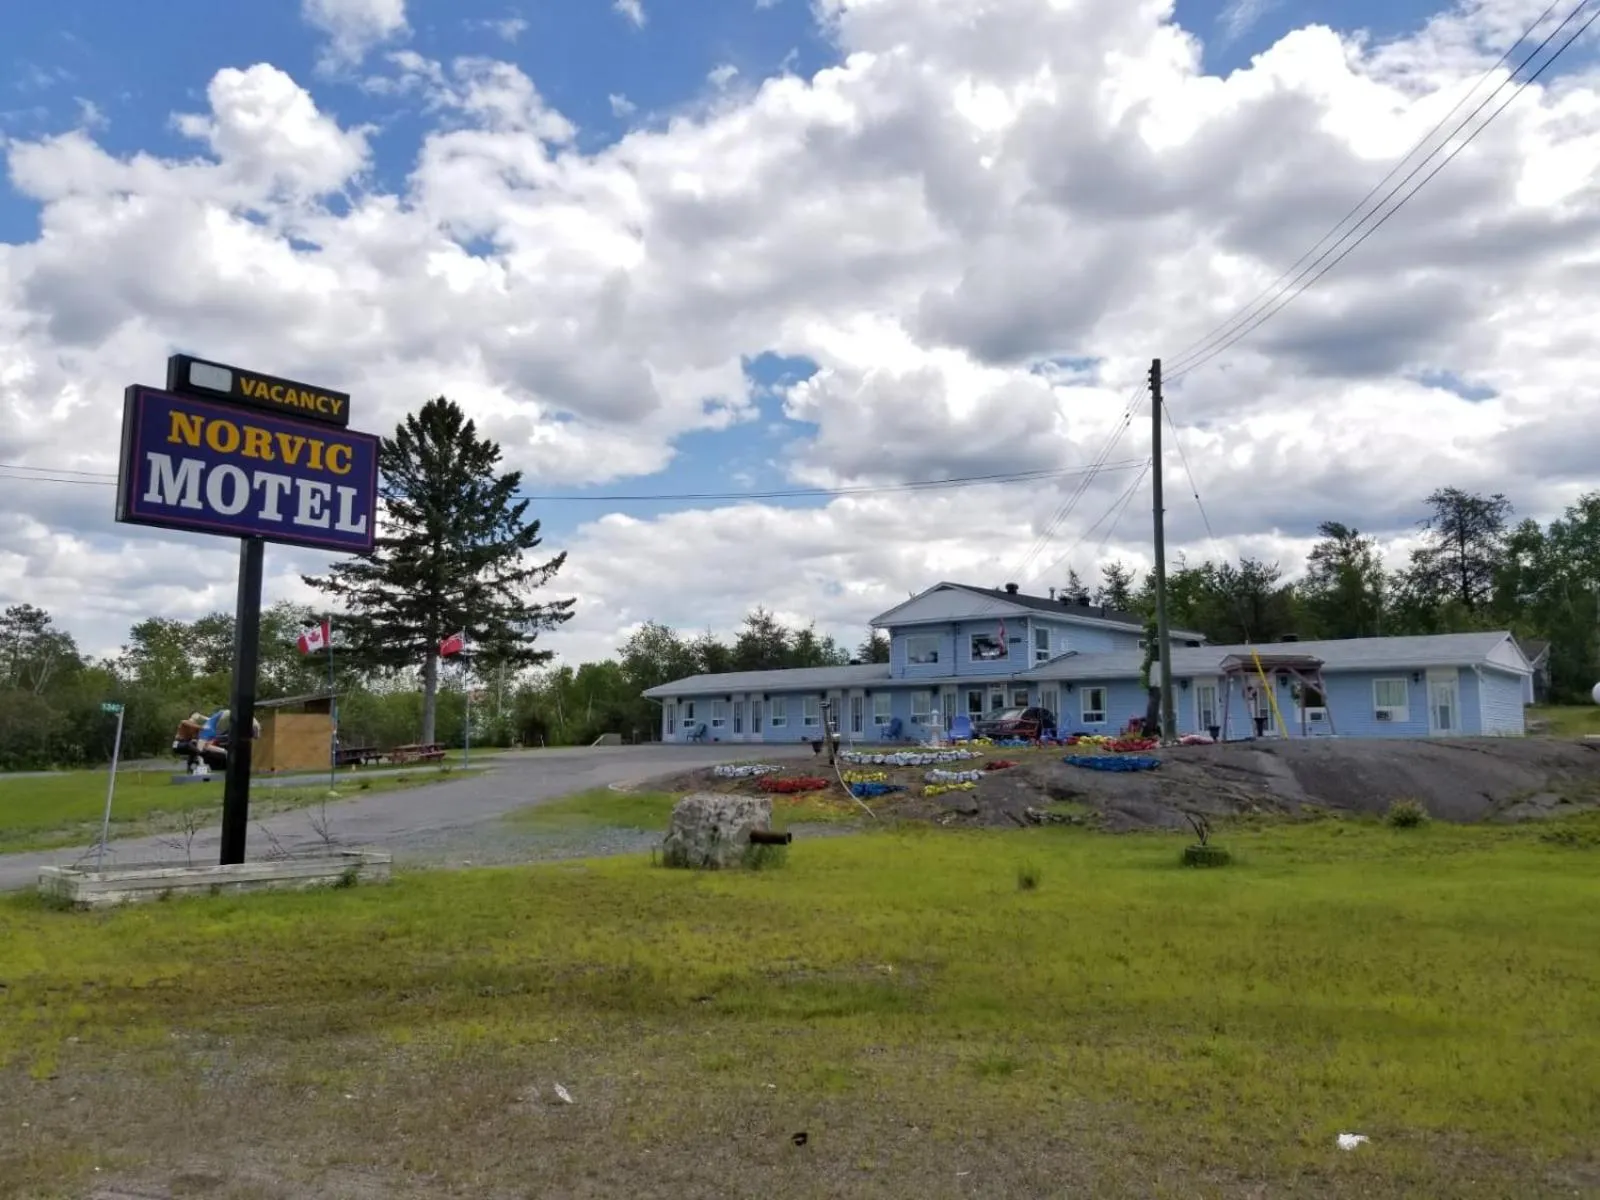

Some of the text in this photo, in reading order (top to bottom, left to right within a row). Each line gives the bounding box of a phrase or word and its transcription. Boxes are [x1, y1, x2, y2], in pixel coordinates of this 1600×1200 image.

[240, 376, 344, 415] VACANCY
[167, 410, 353, 475] NORVIC
[143, 451, 367, 534] MOTEL
